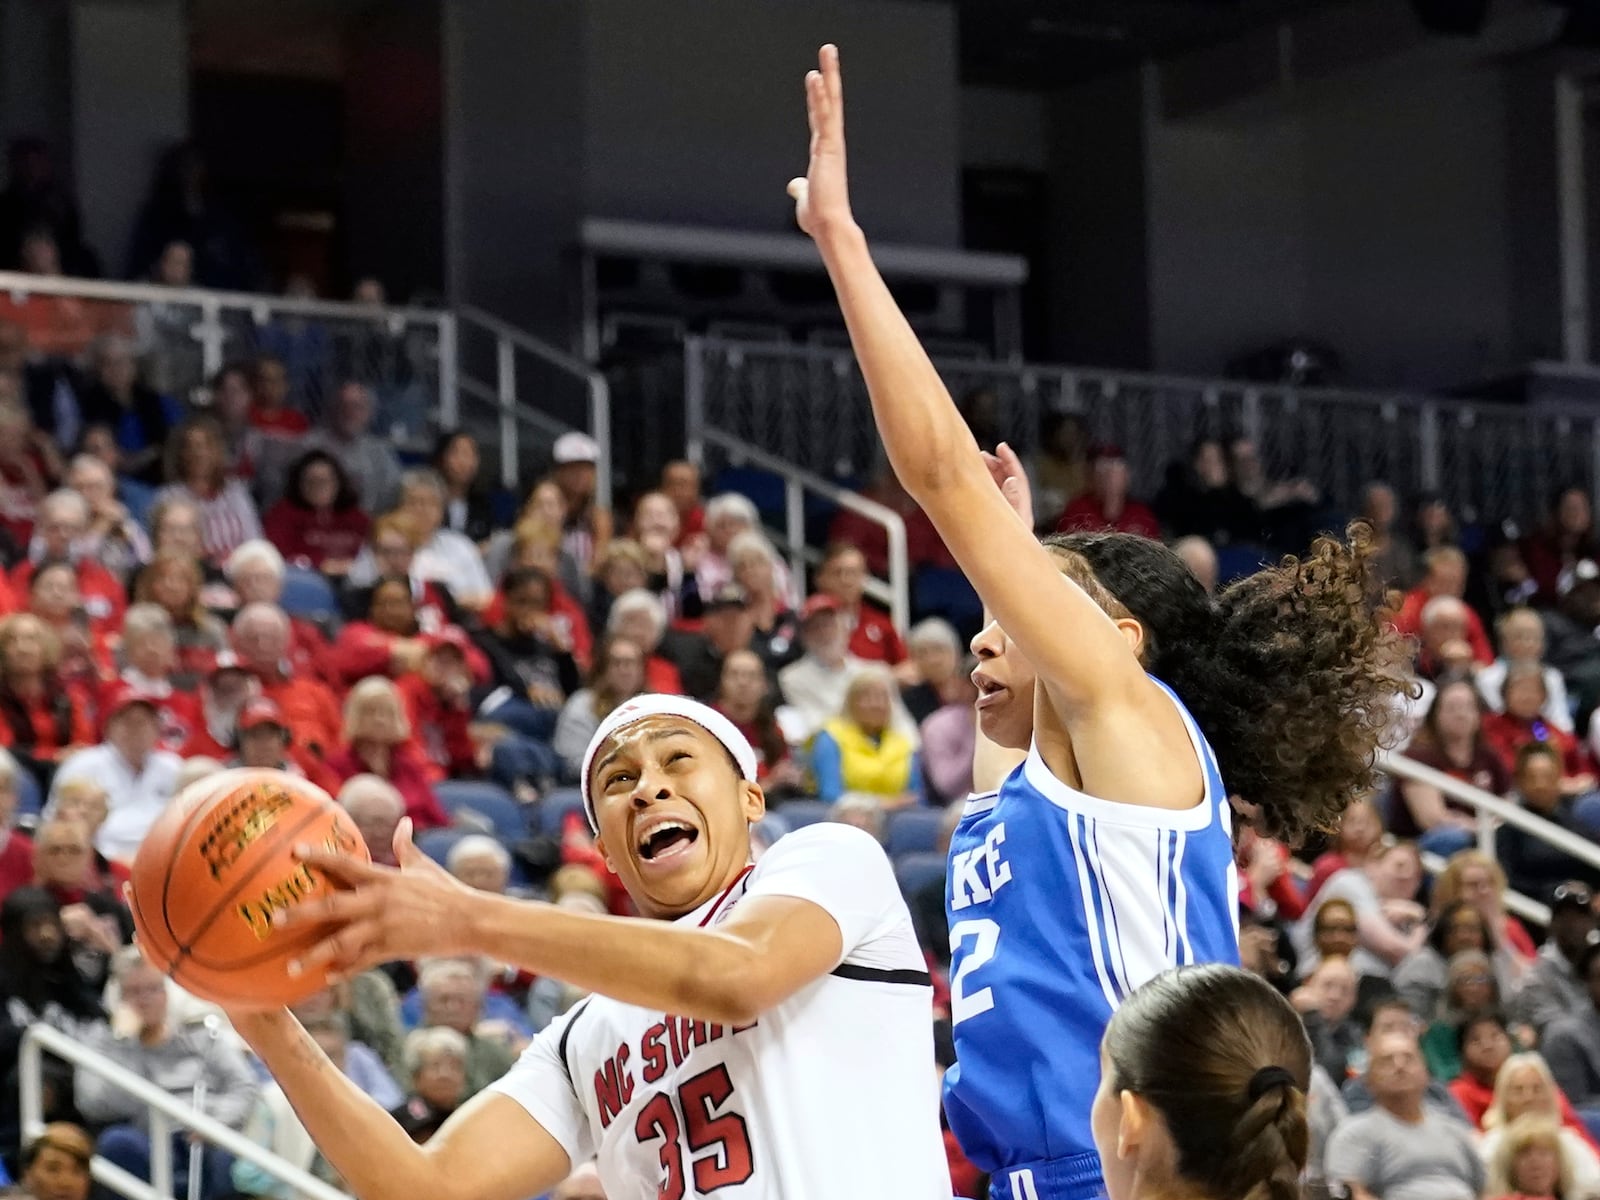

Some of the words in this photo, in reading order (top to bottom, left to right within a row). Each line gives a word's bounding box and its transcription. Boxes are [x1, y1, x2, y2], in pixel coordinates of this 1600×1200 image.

[951, 822, 1012, 911] KE
[594, 1041, 635, 1129] NC
[641, 1014, 758, 1083] STA
